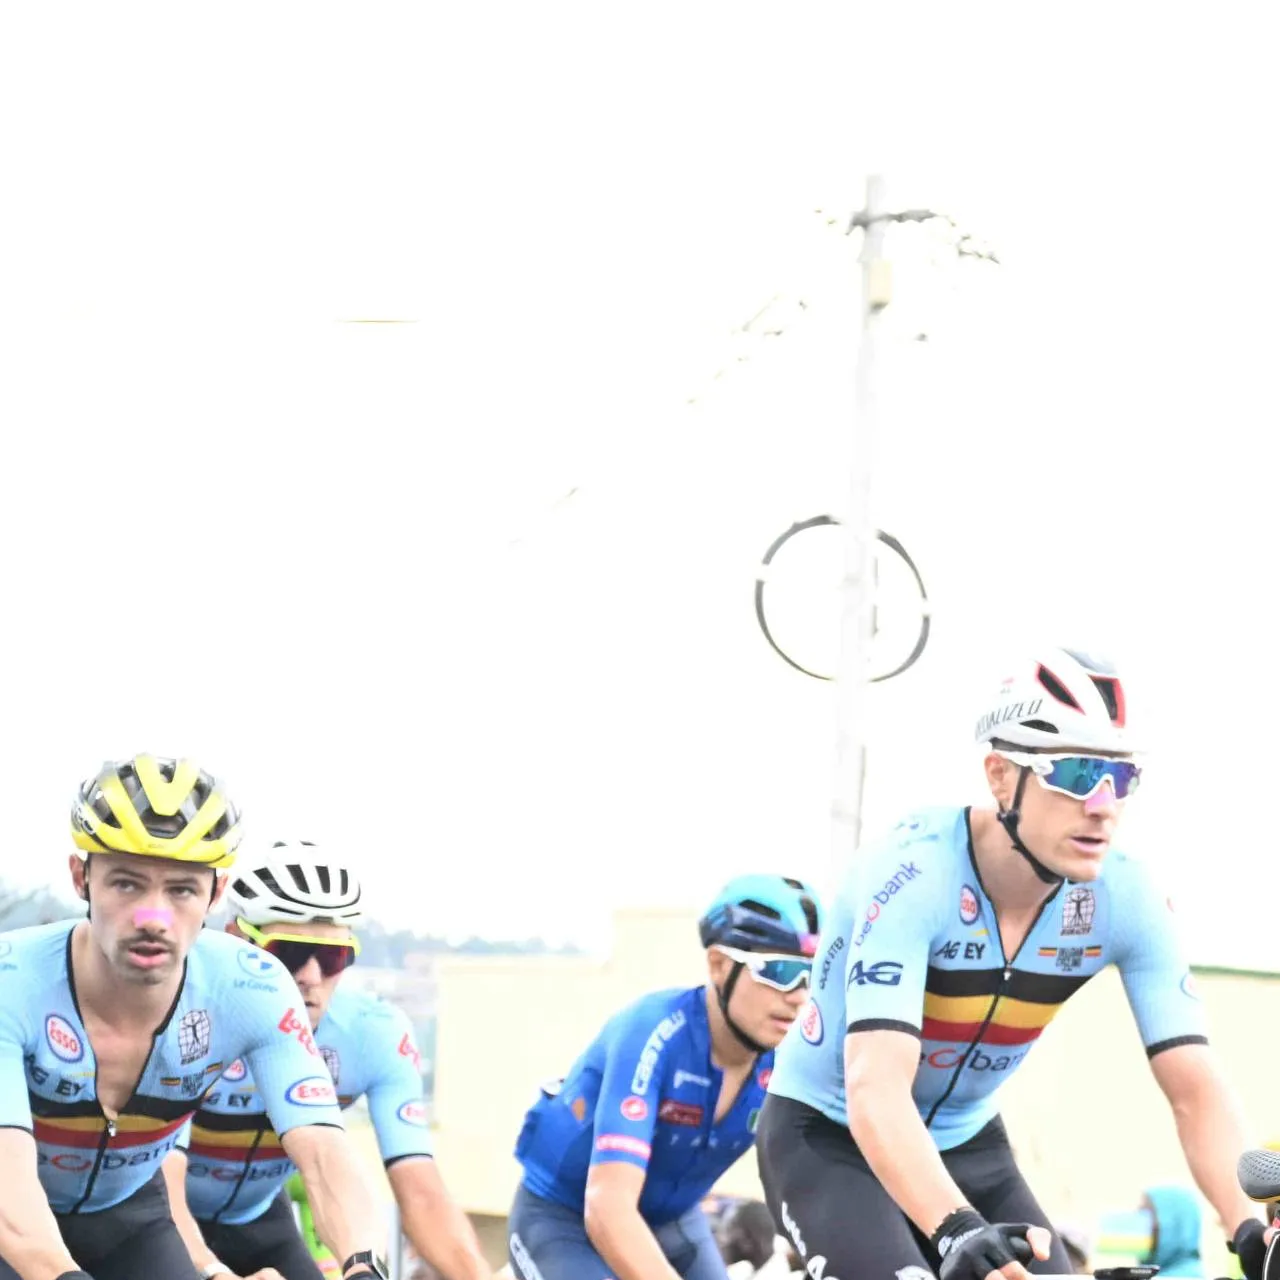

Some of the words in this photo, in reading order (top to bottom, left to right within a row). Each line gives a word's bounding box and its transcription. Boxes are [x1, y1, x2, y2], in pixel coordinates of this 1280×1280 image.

[935, 941, 961, 959] AG
[964, 942, 985, 960] EY
[847, 960, 903, 992] AG
[50, 1020, 78, 1054] Esso
[54, 1079, 84, 1097] EY
[228, 1093, 253, 1108] EY
